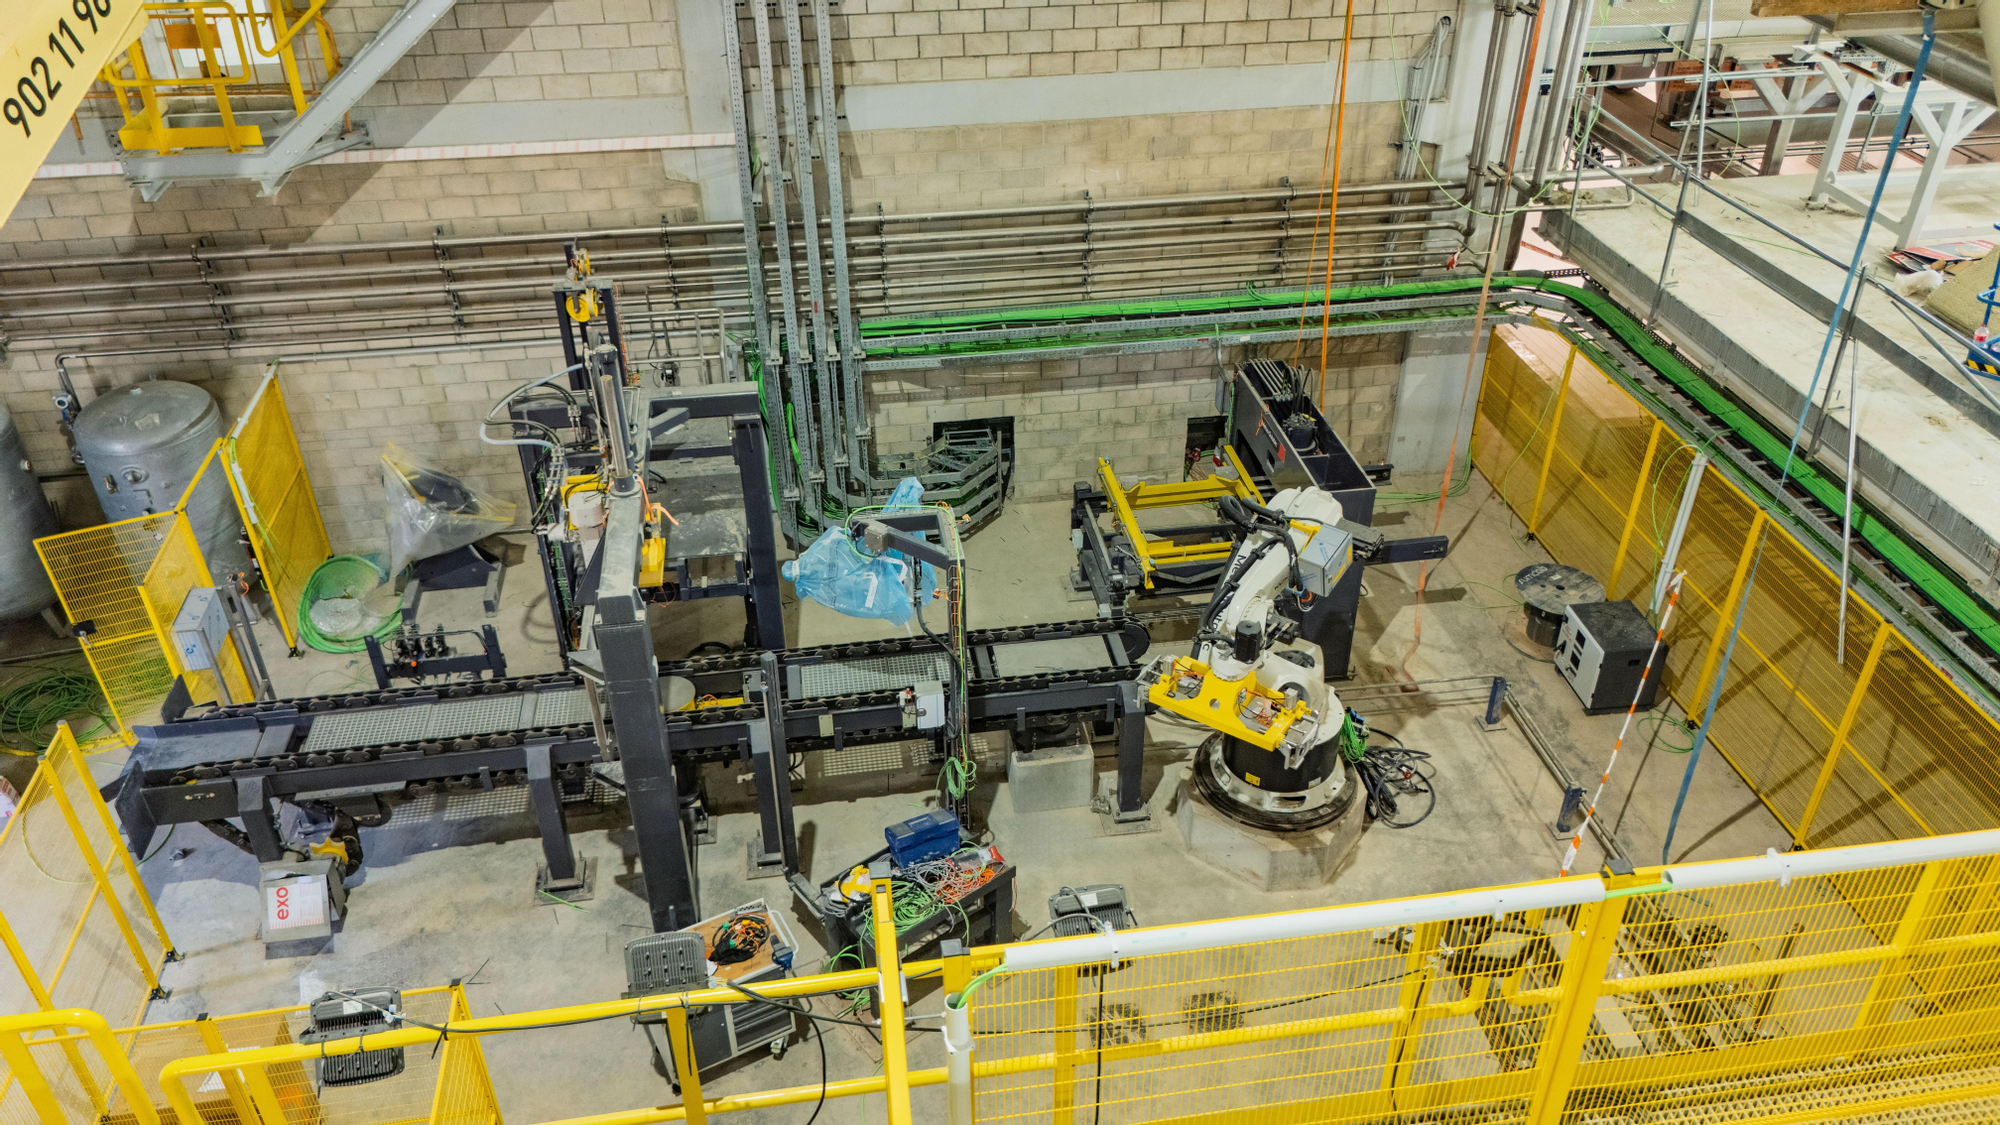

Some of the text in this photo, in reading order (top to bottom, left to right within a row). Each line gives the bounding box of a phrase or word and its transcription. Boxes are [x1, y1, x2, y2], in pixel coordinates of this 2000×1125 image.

[3, 56, 63, 139] 902
[48, 17, 86, 69] 11
[277, 887, 290, 920] exo
